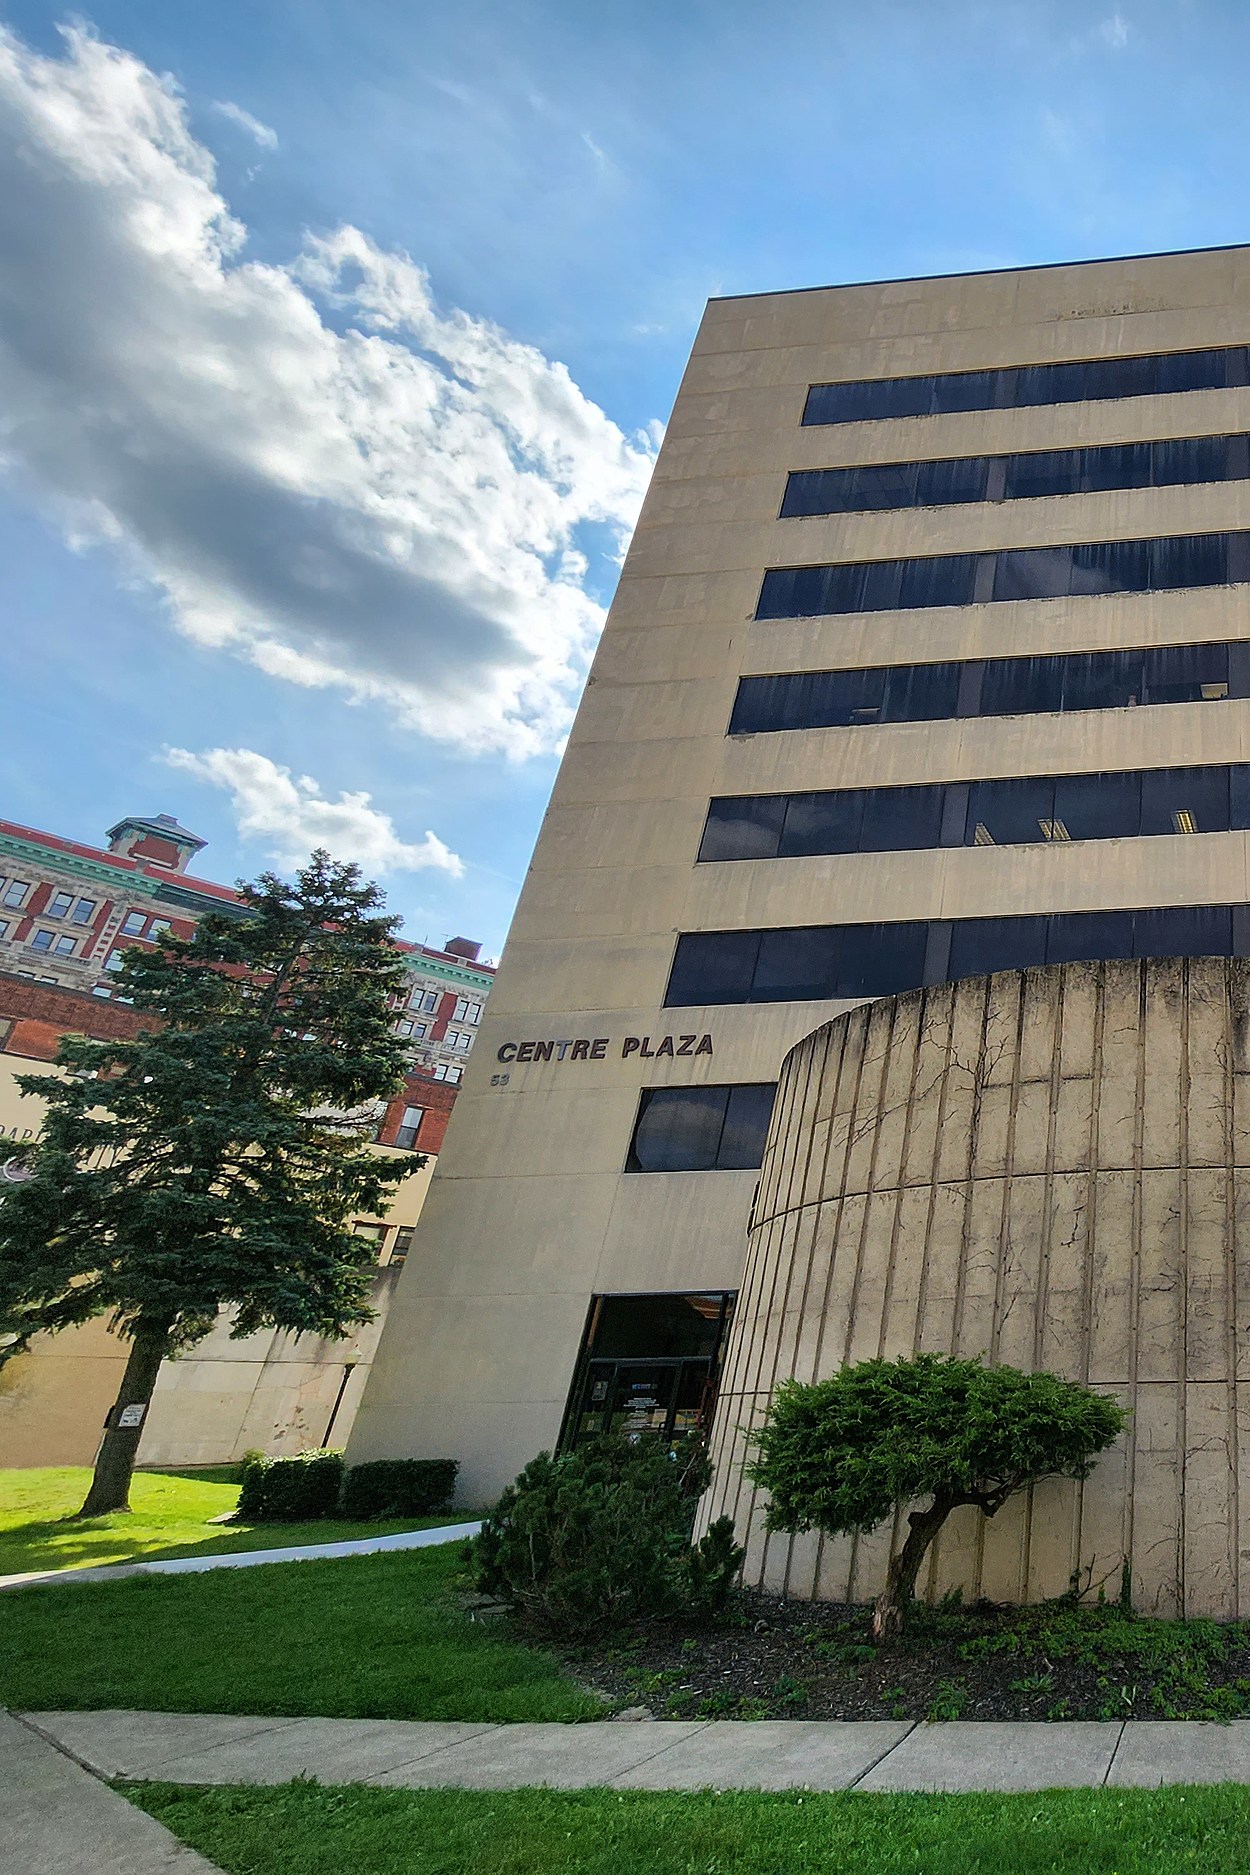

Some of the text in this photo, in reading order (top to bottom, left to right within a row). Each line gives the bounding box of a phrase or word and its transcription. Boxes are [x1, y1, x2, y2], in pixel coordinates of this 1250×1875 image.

[498, 1034, 713, 1063] CENTRE PLAZA
[490, 1073, 510, 1086] 53
